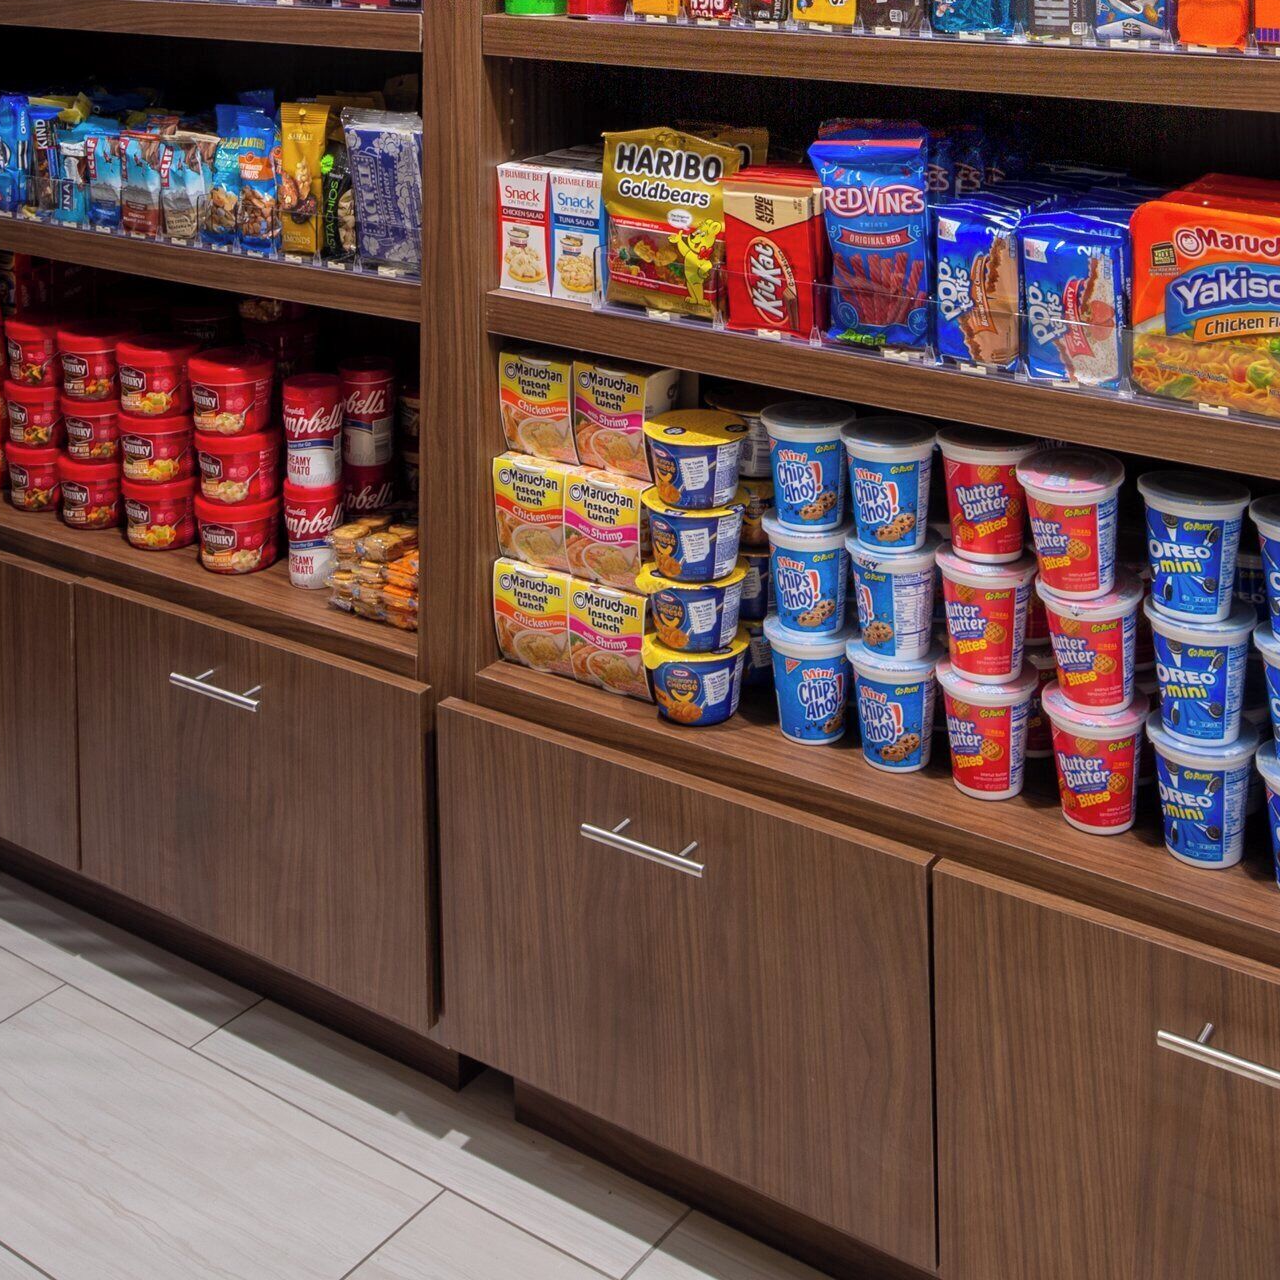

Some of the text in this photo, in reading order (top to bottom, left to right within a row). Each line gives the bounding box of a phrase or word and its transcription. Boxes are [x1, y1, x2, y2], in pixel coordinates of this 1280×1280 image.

[35, 119, 48, 149] KIND
[616, 144, 723, 183] HARIBO
[505, 170, 531, 180] BUMBLE
[558, 177, 585, 186] BUMBLE
[505, 186, 540, 202] Snack
[557, 192, 594, 209] Snack
[619, 180, 710, 207] Goldbears
[503, 209, 525, 217] CHICKEN
[755, 195, 764, 222] KING
[764, 200, 775, 225] SIZE
[849, 234, 901, 246] ORIGINAL RED
[1205, 317, 1264, 336] Chicken
[515, 363, 563, 383] Maruchan
[518, 378, 551, 391] Instant
[588, 371, 639, 394] Maruchan
[521, 386, 548, 399] Lunch
[591, 386, 626, 403] Instant
[518, 399, 551, 415] Chicken
[594, 398, 622, 411] Lunch
[598, 412, 629, 429] Shrimp
[778, 449, 807, 463] Mini
[777, 463, 813, 485] Chips
[956, 483, 1004, 504] Nutter
[962, 496, 1009, 519] Butter
[977, 518, 1008, 536] Bites
[202, 531, 234, 546] CHUNKY
[1148, 541, 1211, 564] OREO
[1159, 559, 1202, 575] mini
